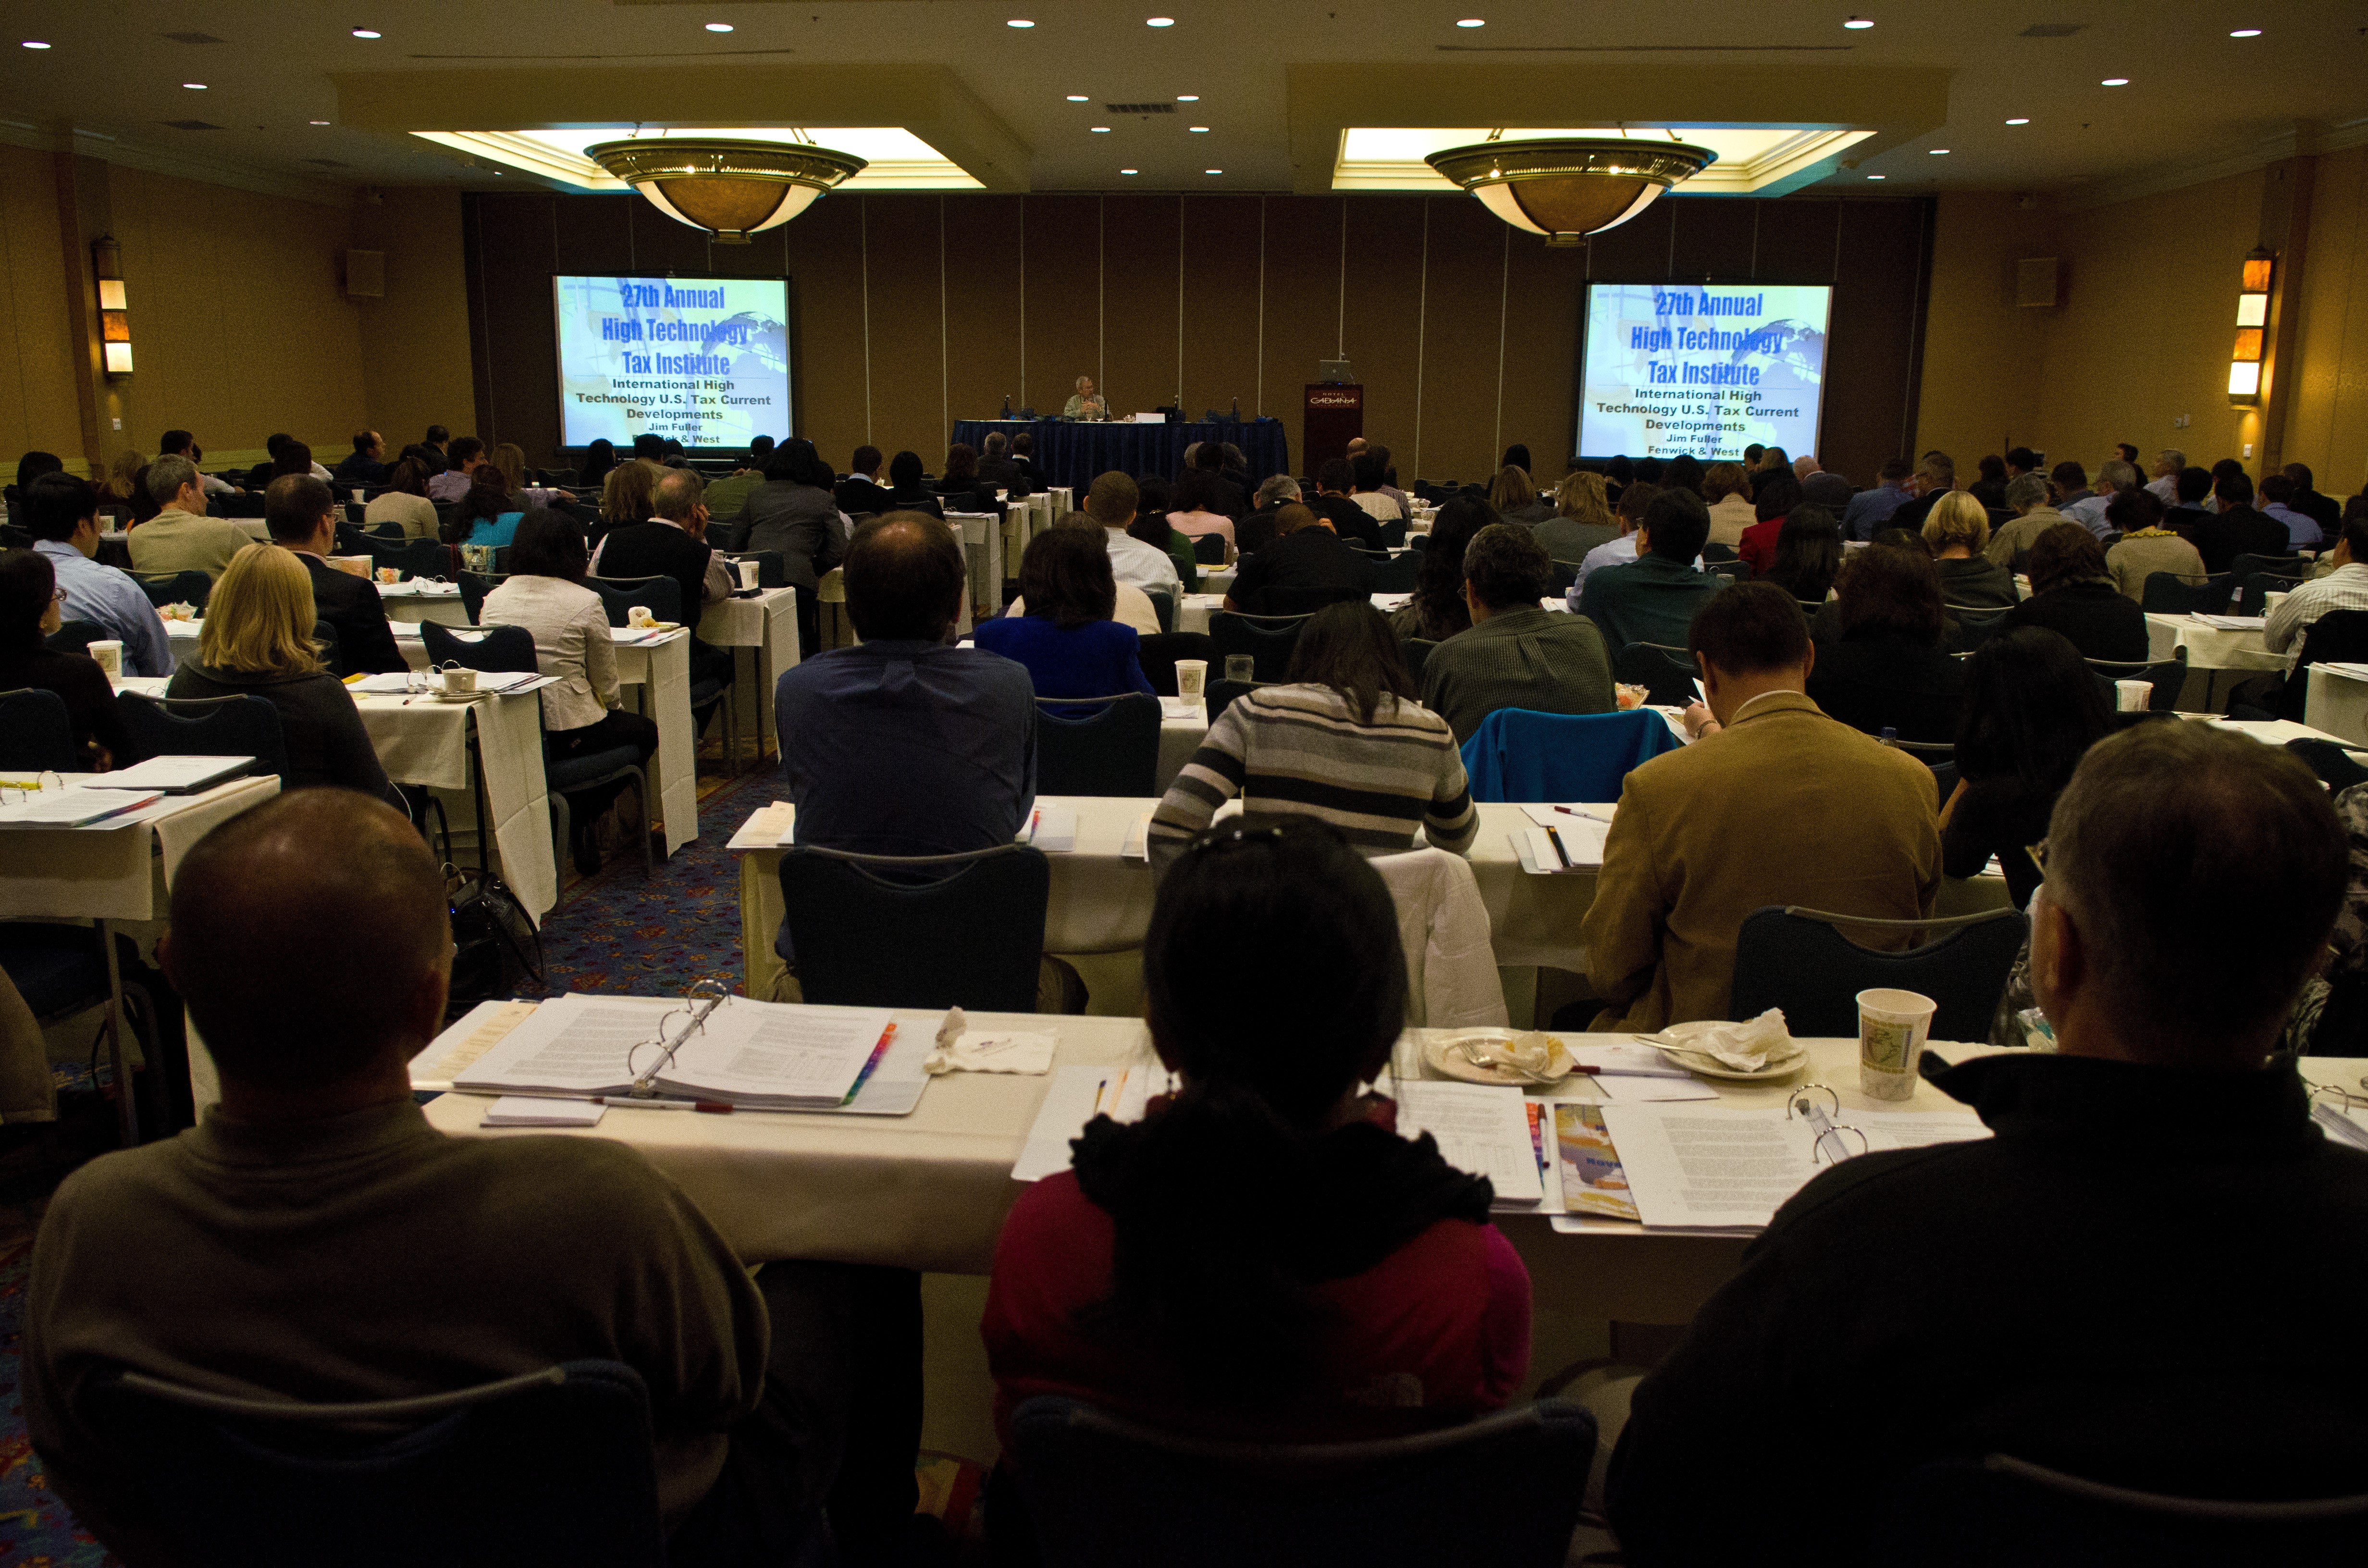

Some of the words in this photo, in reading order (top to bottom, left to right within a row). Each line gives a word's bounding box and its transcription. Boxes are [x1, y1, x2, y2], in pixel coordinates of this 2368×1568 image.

[622, 284, 659, 307] 27th
[664, 285, 725, 308] Annual
[1656, 292, 1694, 315] 27th
[1698, 292, 1763, 316] Annual
[602, 318, 642, 343] High
[646, 318, 747, 345] Technology
[1631, 326, 1672, 352] High
[1677, 327, 1783, 355] Technology
[622, 351, 652, 373] Tax
[656, 353, 730, 375] Institute
[1649, 360, 1677, 383] Tax
[1683, 361, 1760, 385] Institute
[613, 379, 700, 390] International
[704, 380, 734, 392] High
[576, 393, 655, 405] Technology
[660, 394, 686, 404] U.S.
[691, 395, 716, 404] Tax
[721, 395, 771, 405] Current
[1635, 389, 1725, 400] International
[1729, 390, 1762, 403] High
[627, 409, 723, 421] Developments
[1597, 403, 1677, 416] Technology
[1682, 404, 1708, 415] U.S.
[1714, 405, 1740, 416] Tax
[1746, 406, 1799, 417] Current
[1646, 419, 1746, 432] Developments
[1666, 434, 1687, 442] Jim
[1690, 435, 1722, 443] Fuller
[1648, 446, 1694, 455] Fenwick
[1698, 447, 1706, 455] &
[1711, 447, 1739, 456] West
